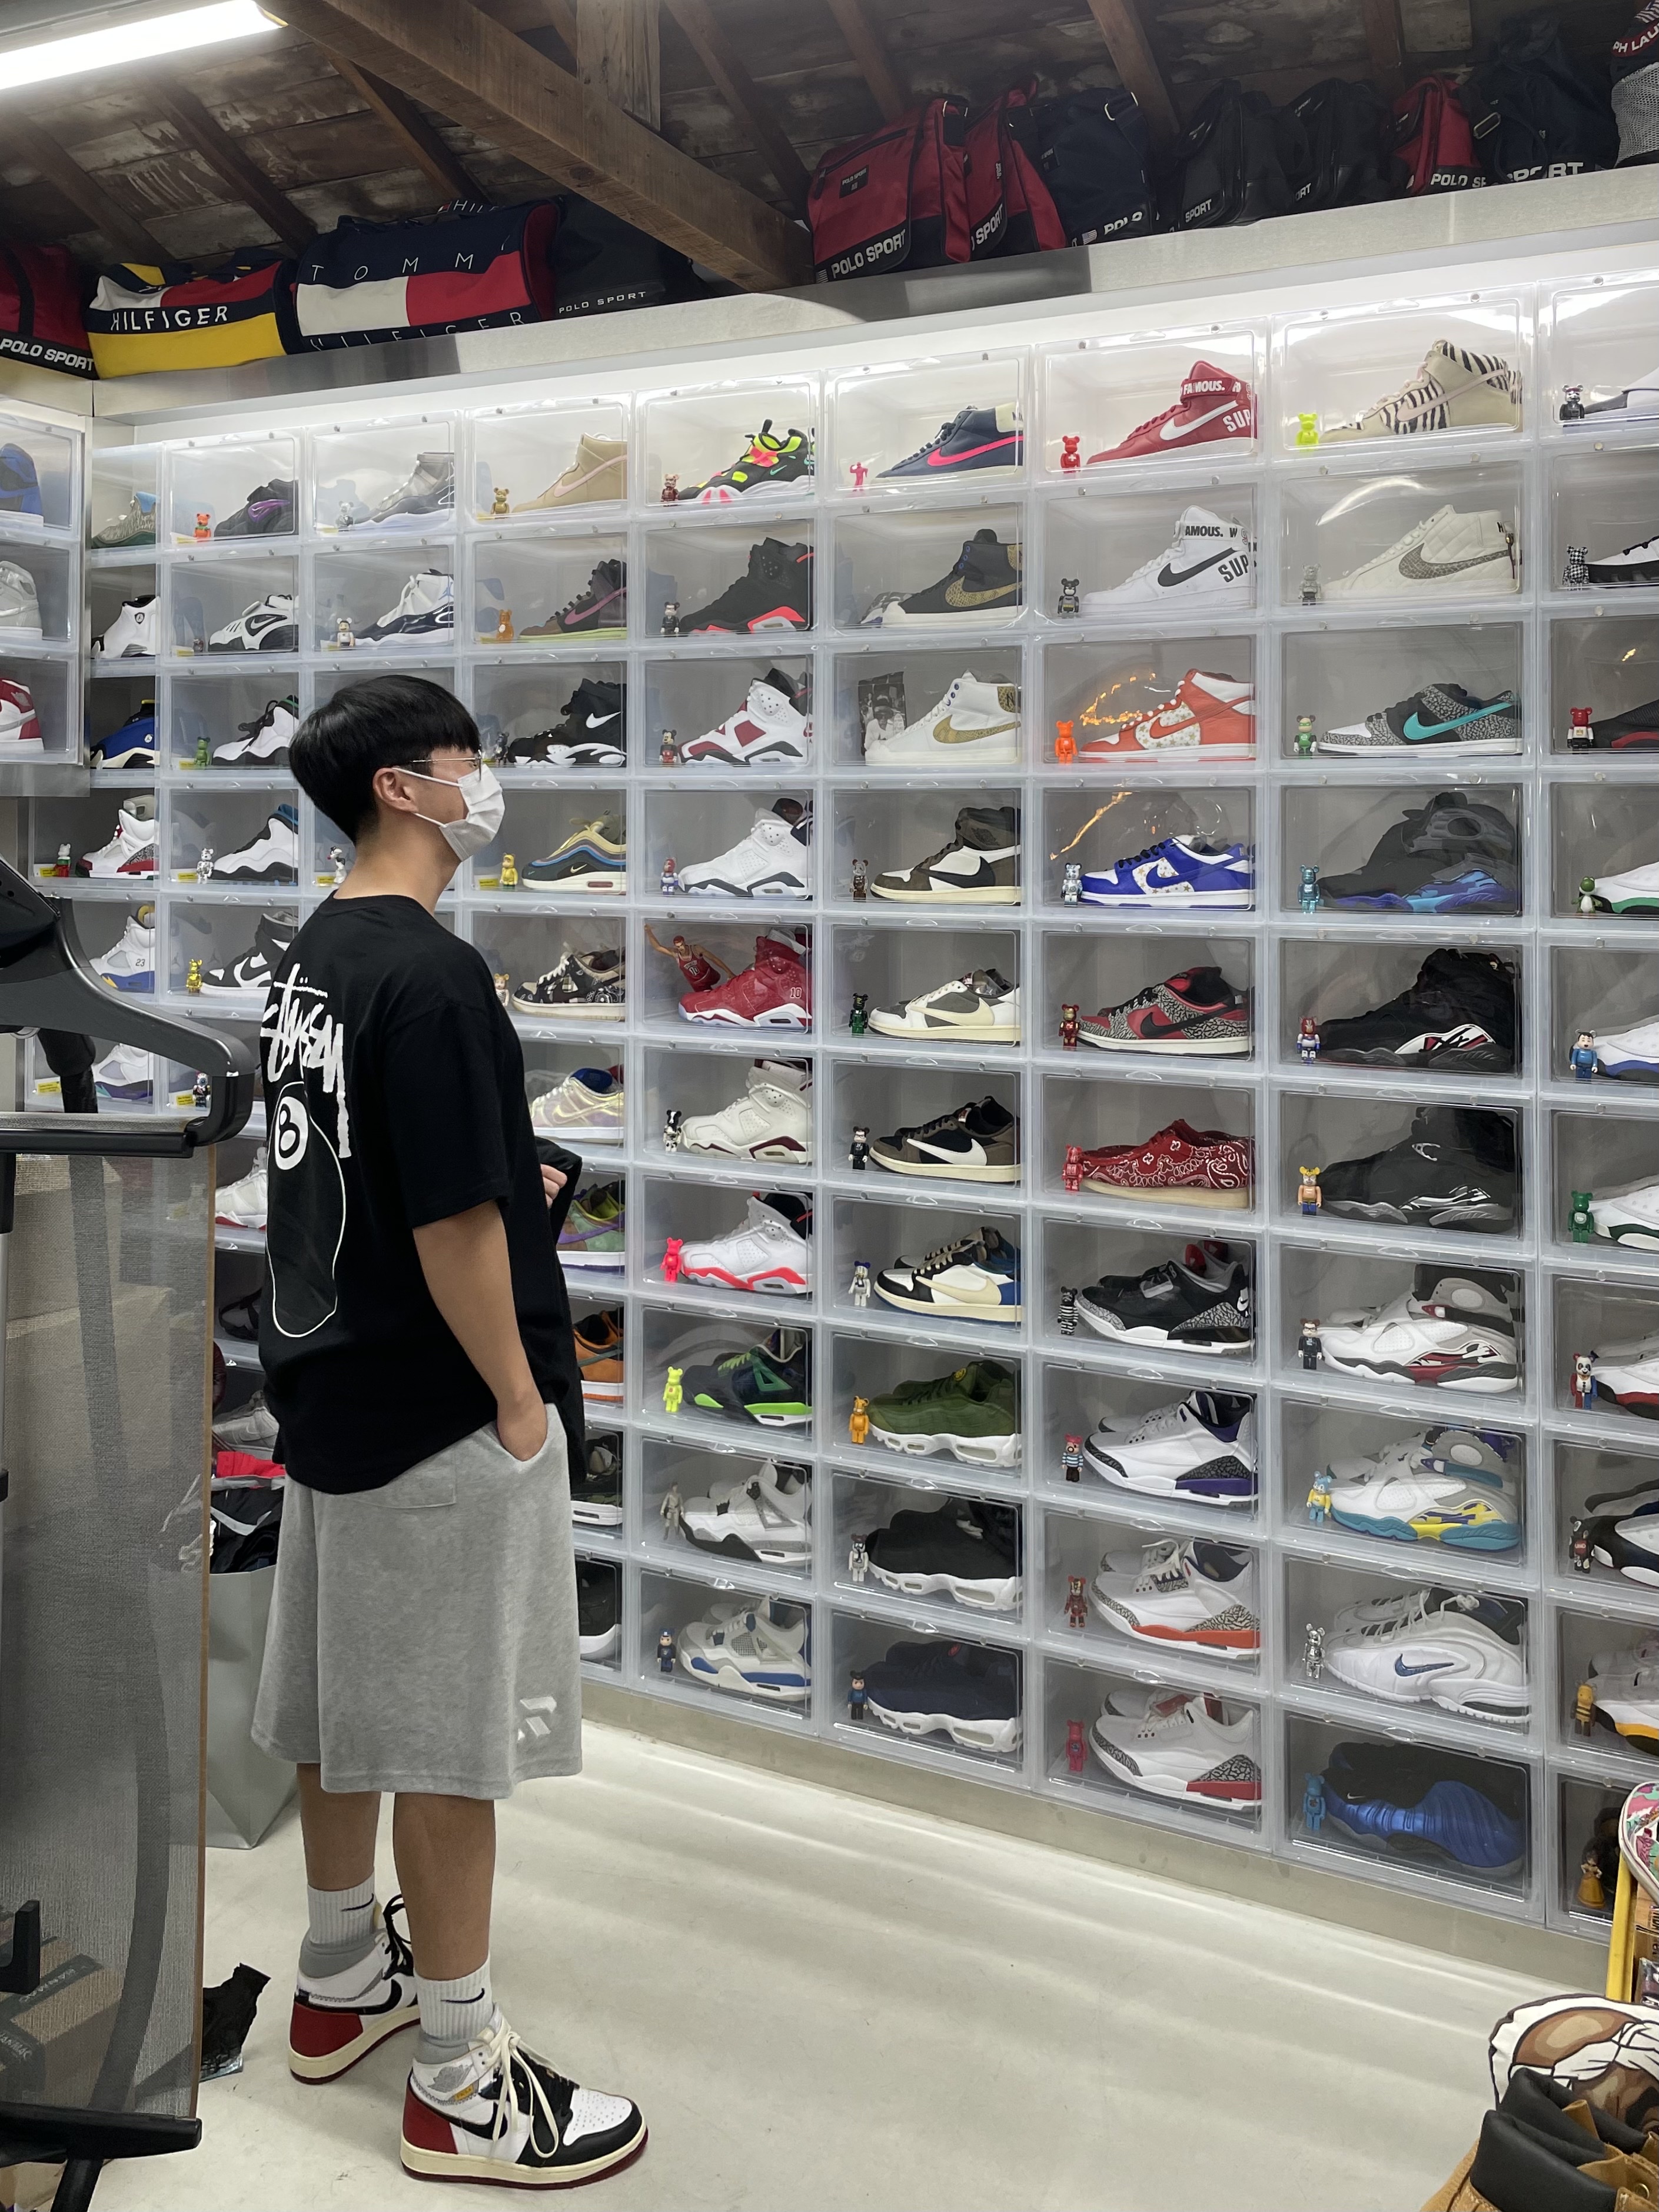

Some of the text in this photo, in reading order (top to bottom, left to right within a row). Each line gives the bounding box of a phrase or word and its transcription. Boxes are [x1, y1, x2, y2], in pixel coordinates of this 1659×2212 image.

[1631, 22, 1659, 51] LAU
[1430, 173, 1468, 187] POLO
[1185, 199, 1212, 224] SPORT
[975, 204, 1003, 246] SPORT
[830, 229, 906, 280] POLO SPORT
[558, 290, 647, 314] POLO SPORT
[110, 305, 229, 331] HILFIGER
[0, 338, 94, 371] POLO SPORT
[135, 958, 146, 967] 23
[790, 987, 802, 999] 10
